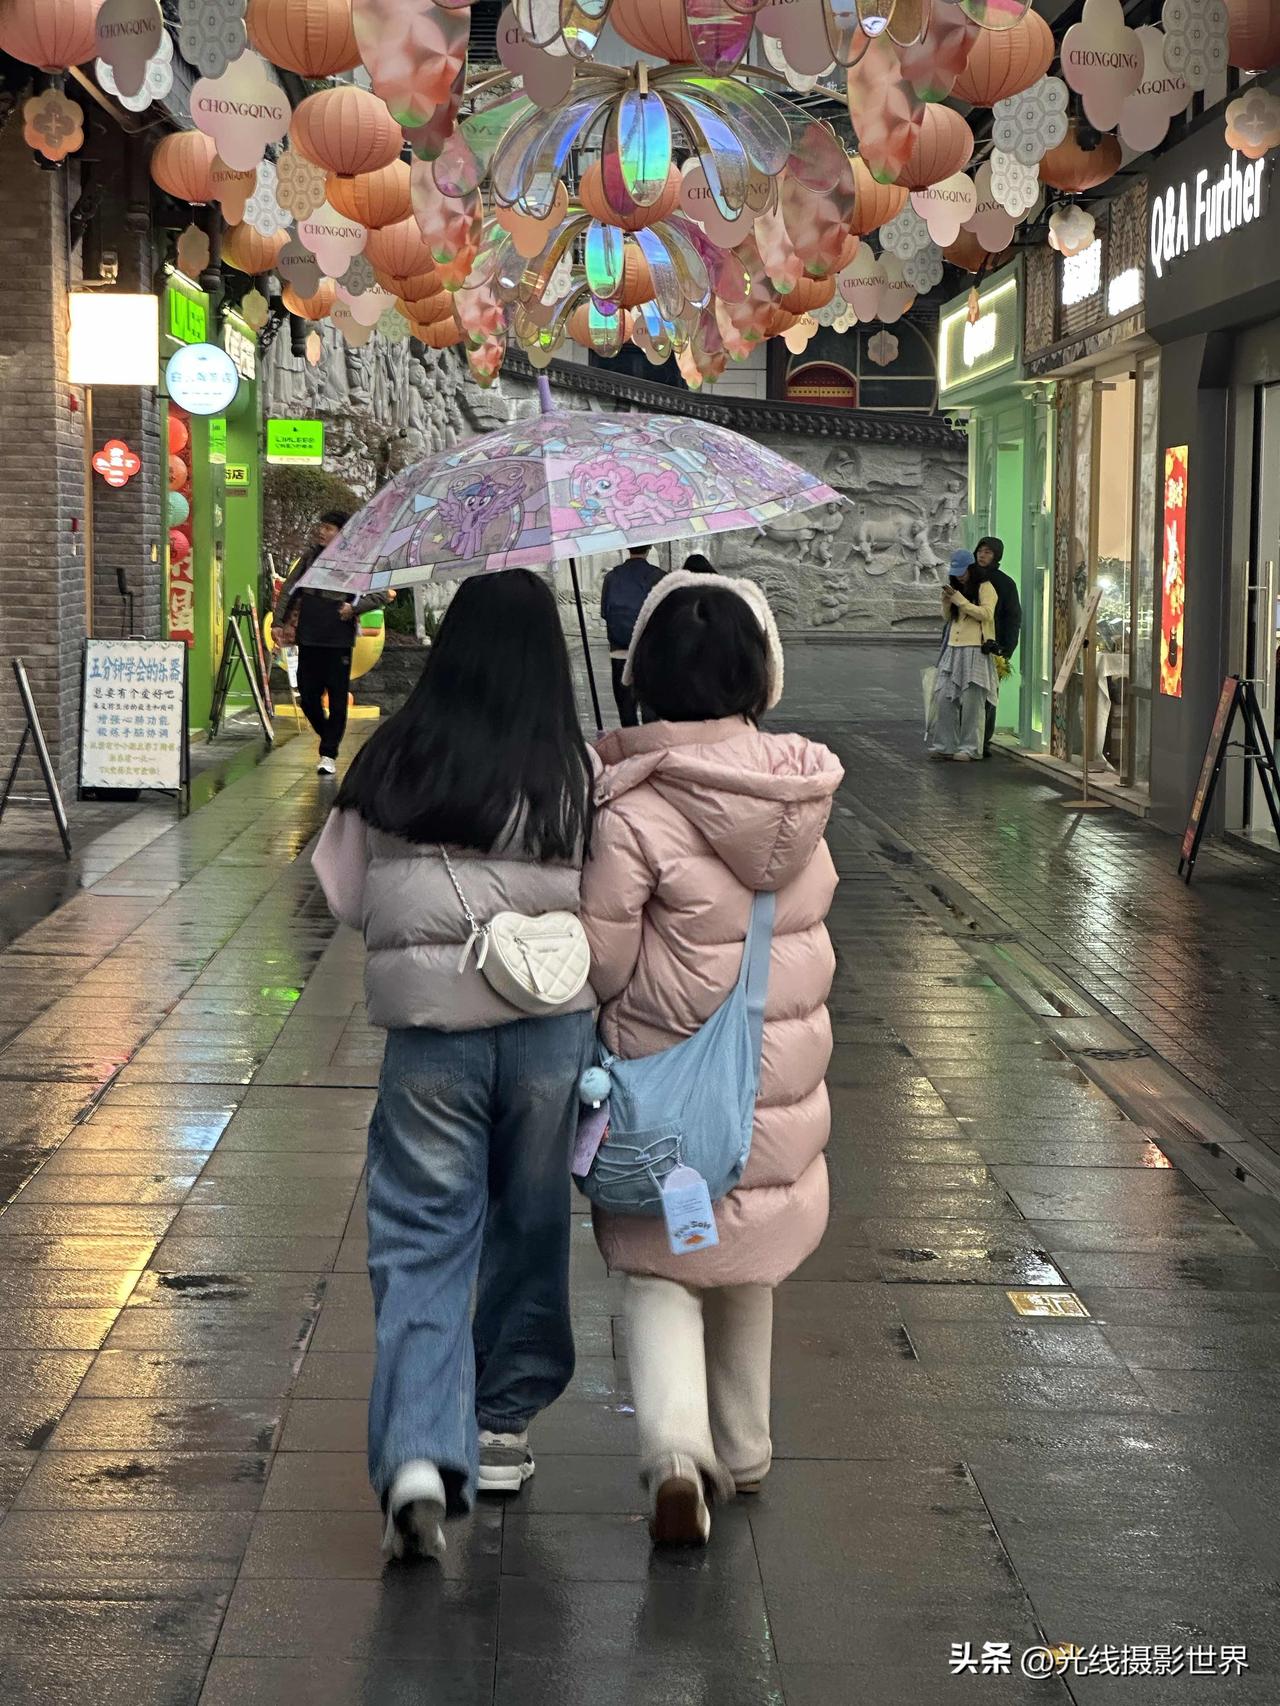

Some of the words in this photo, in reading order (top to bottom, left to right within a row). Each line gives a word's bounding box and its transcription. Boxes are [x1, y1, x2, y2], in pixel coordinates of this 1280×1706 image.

[100, 17, 156, 39] CHONGQING
[1069, 50, 1138, 69] CHONGQING
[199, 98, 283, 121] CHONGQING
[1151, 182, 1189, 278] Q&A
[1194, 149, 1265, 246] Further
[303, 224, 362, 239] CHONGQING
[281, 254, 318, 266] CHONGQ
[89, 656, 181, 682] 五分钟学会的乐器
[93, 687, 175, 700] 总要有个爱好吧
[97, 714, 170, 727] 增强心肺功能
